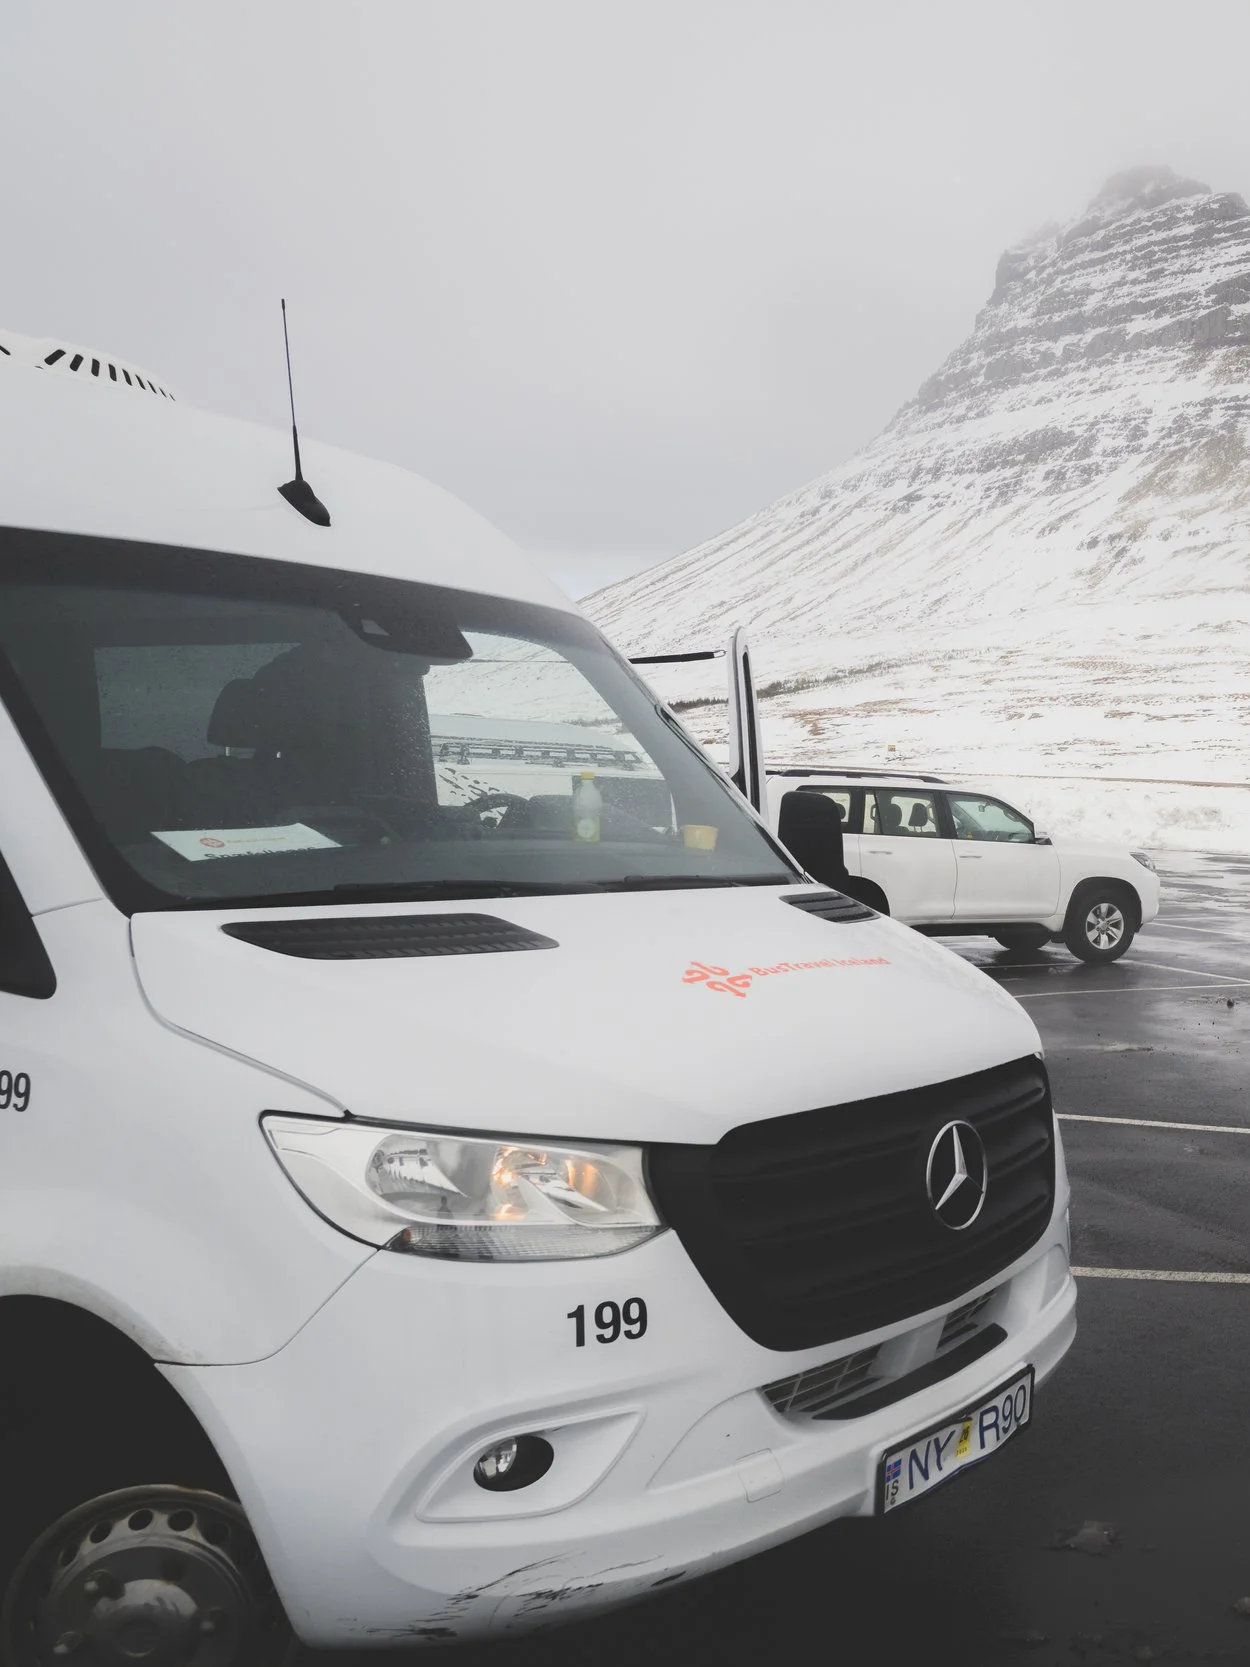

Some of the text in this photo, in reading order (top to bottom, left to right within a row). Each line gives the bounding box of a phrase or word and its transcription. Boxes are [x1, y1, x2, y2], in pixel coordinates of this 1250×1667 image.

[748, 959, 833, 976] BusTravel
[567, 1297, 648, 1347] 199
[908, 1384, 1027, 1491] NY R90
[886, 1479, 899, 1501] IS
